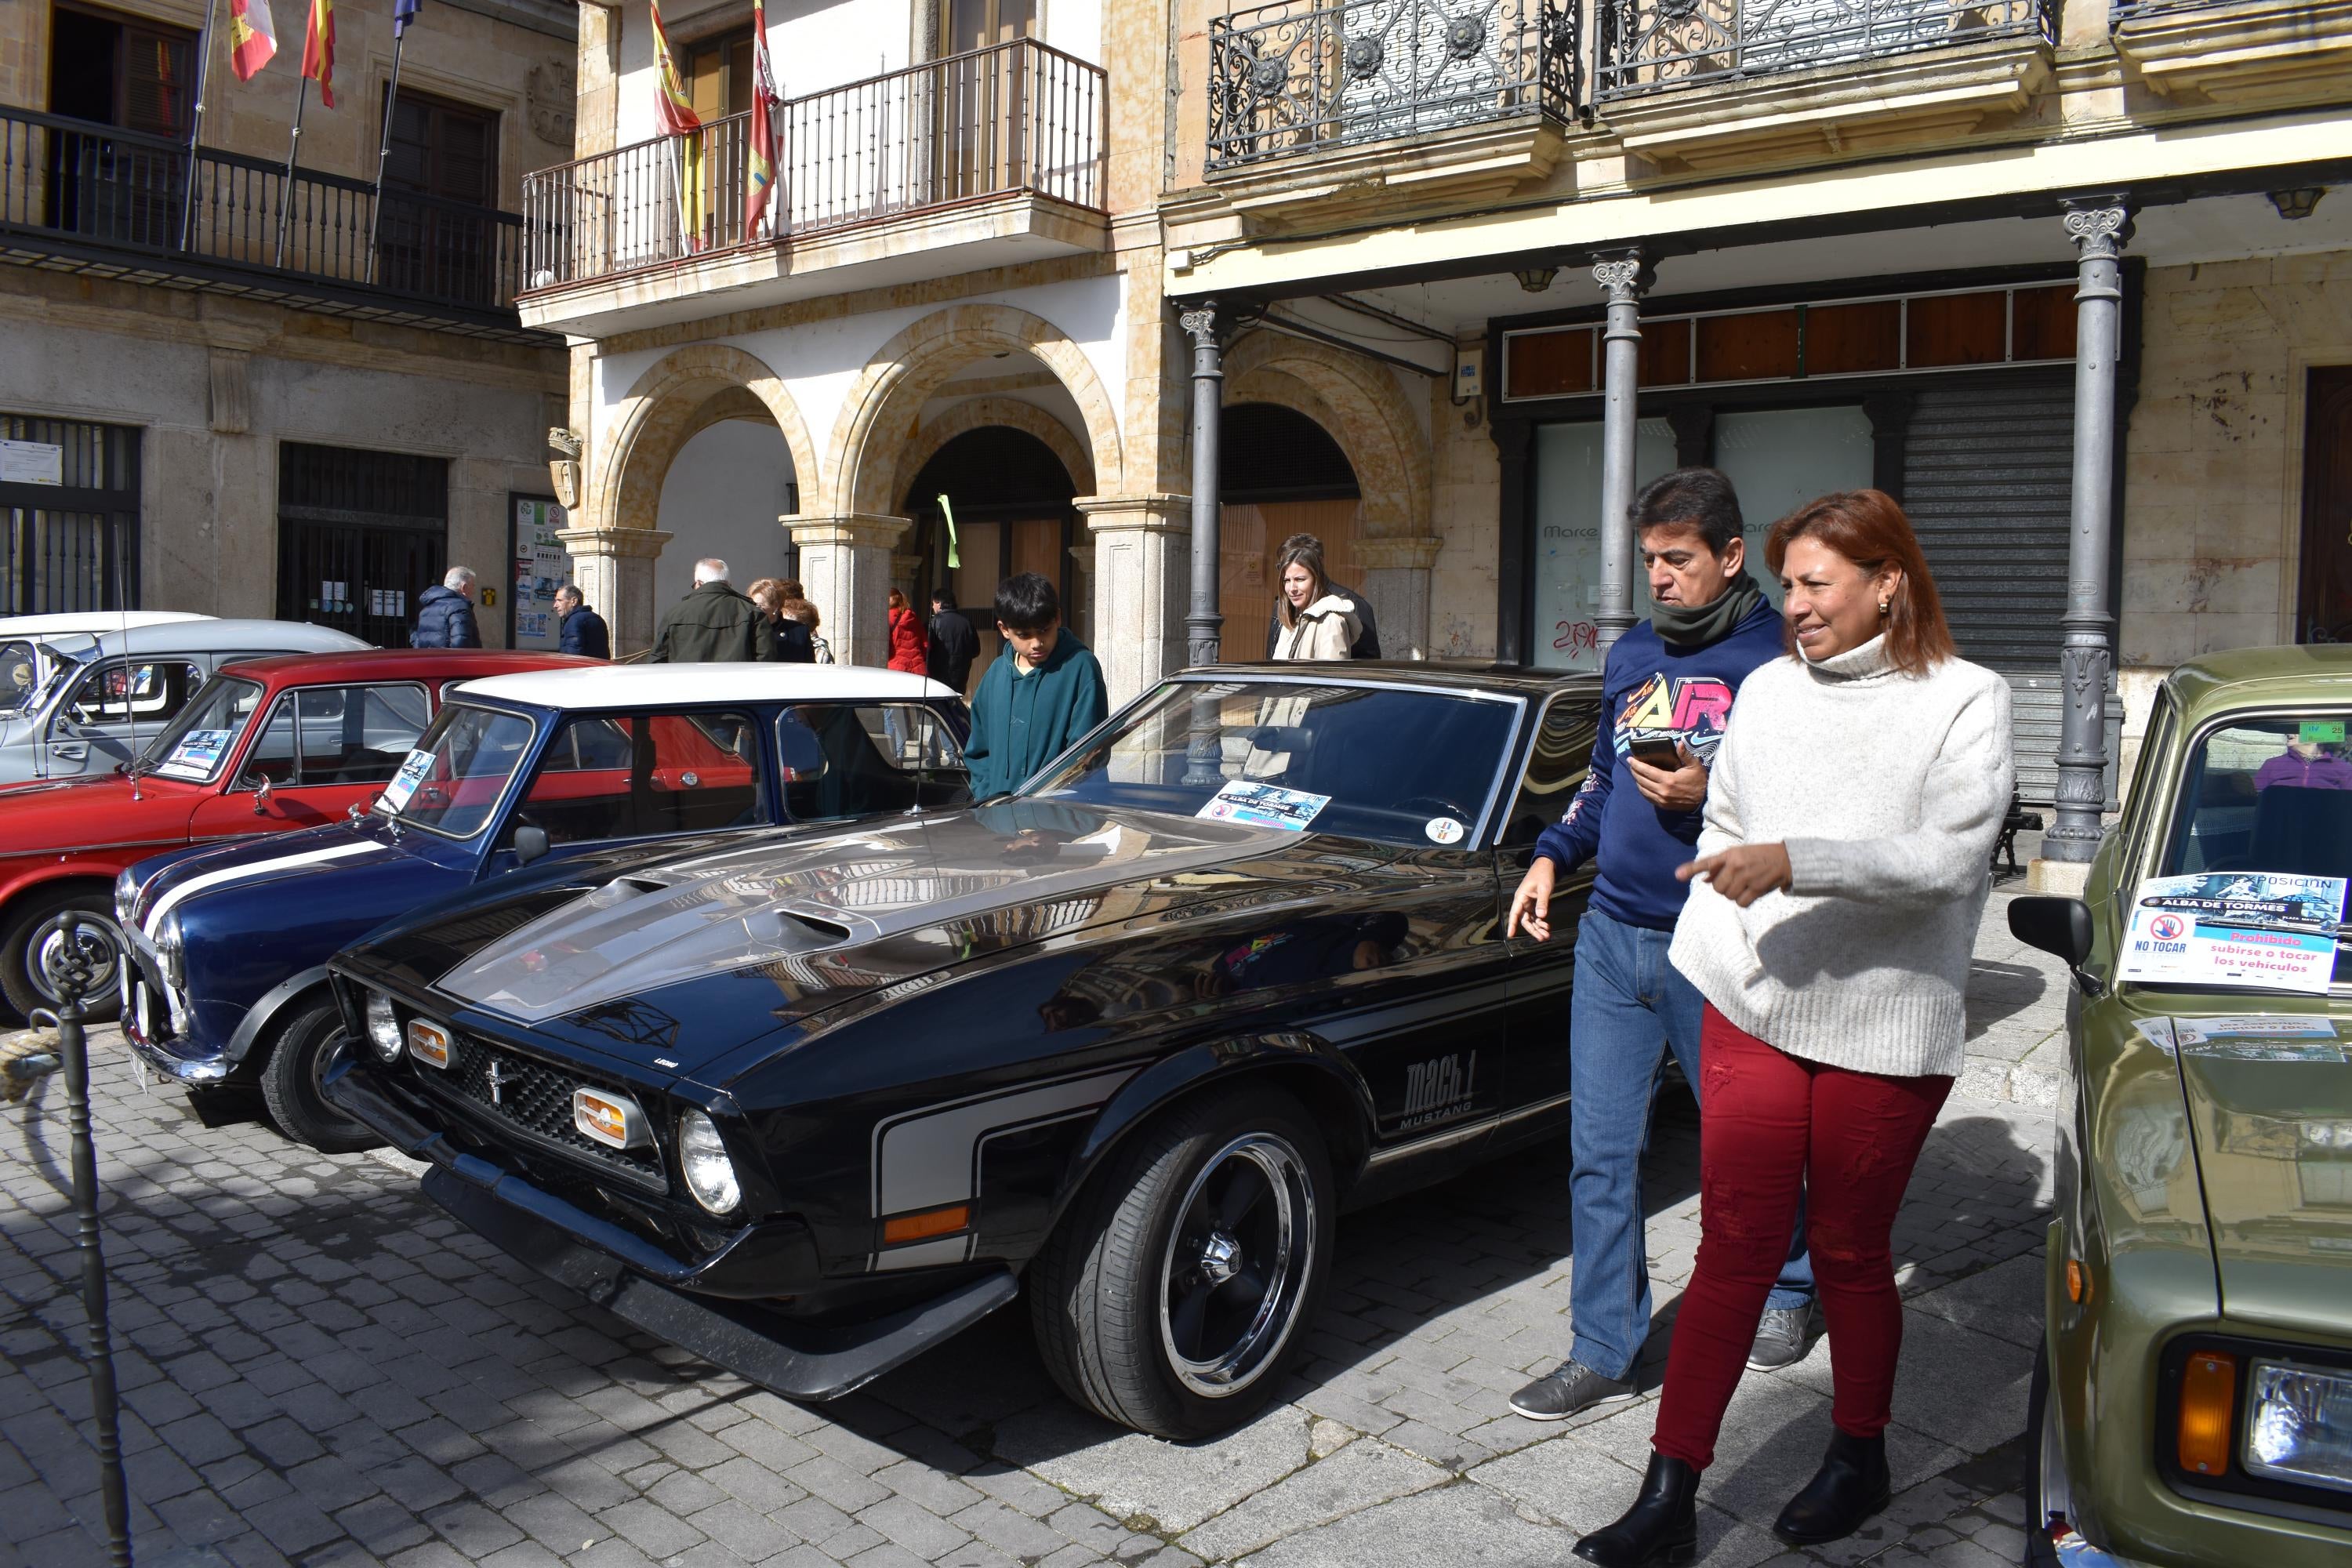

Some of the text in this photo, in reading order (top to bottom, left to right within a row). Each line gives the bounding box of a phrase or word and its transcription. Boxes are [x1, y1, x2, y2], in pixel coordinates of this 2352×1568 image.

[1259, 801, 1290, 810] TORMES
[1250, 816, 1286, 828] Prohibido
[2162, 899, 2287, 912] ALBA DE TORMES
[2230, 931, 2303, 946] Prohibido
[2134, 940, 2187, 953] NO TOCAR
[2210, 943, 2261, 956] subirse
[2280, 949, 2318, 961] tocar
[2214, 956, 2308, 973] los vehículos
[1399, 1102, 1472, 1130] MUSTANG
